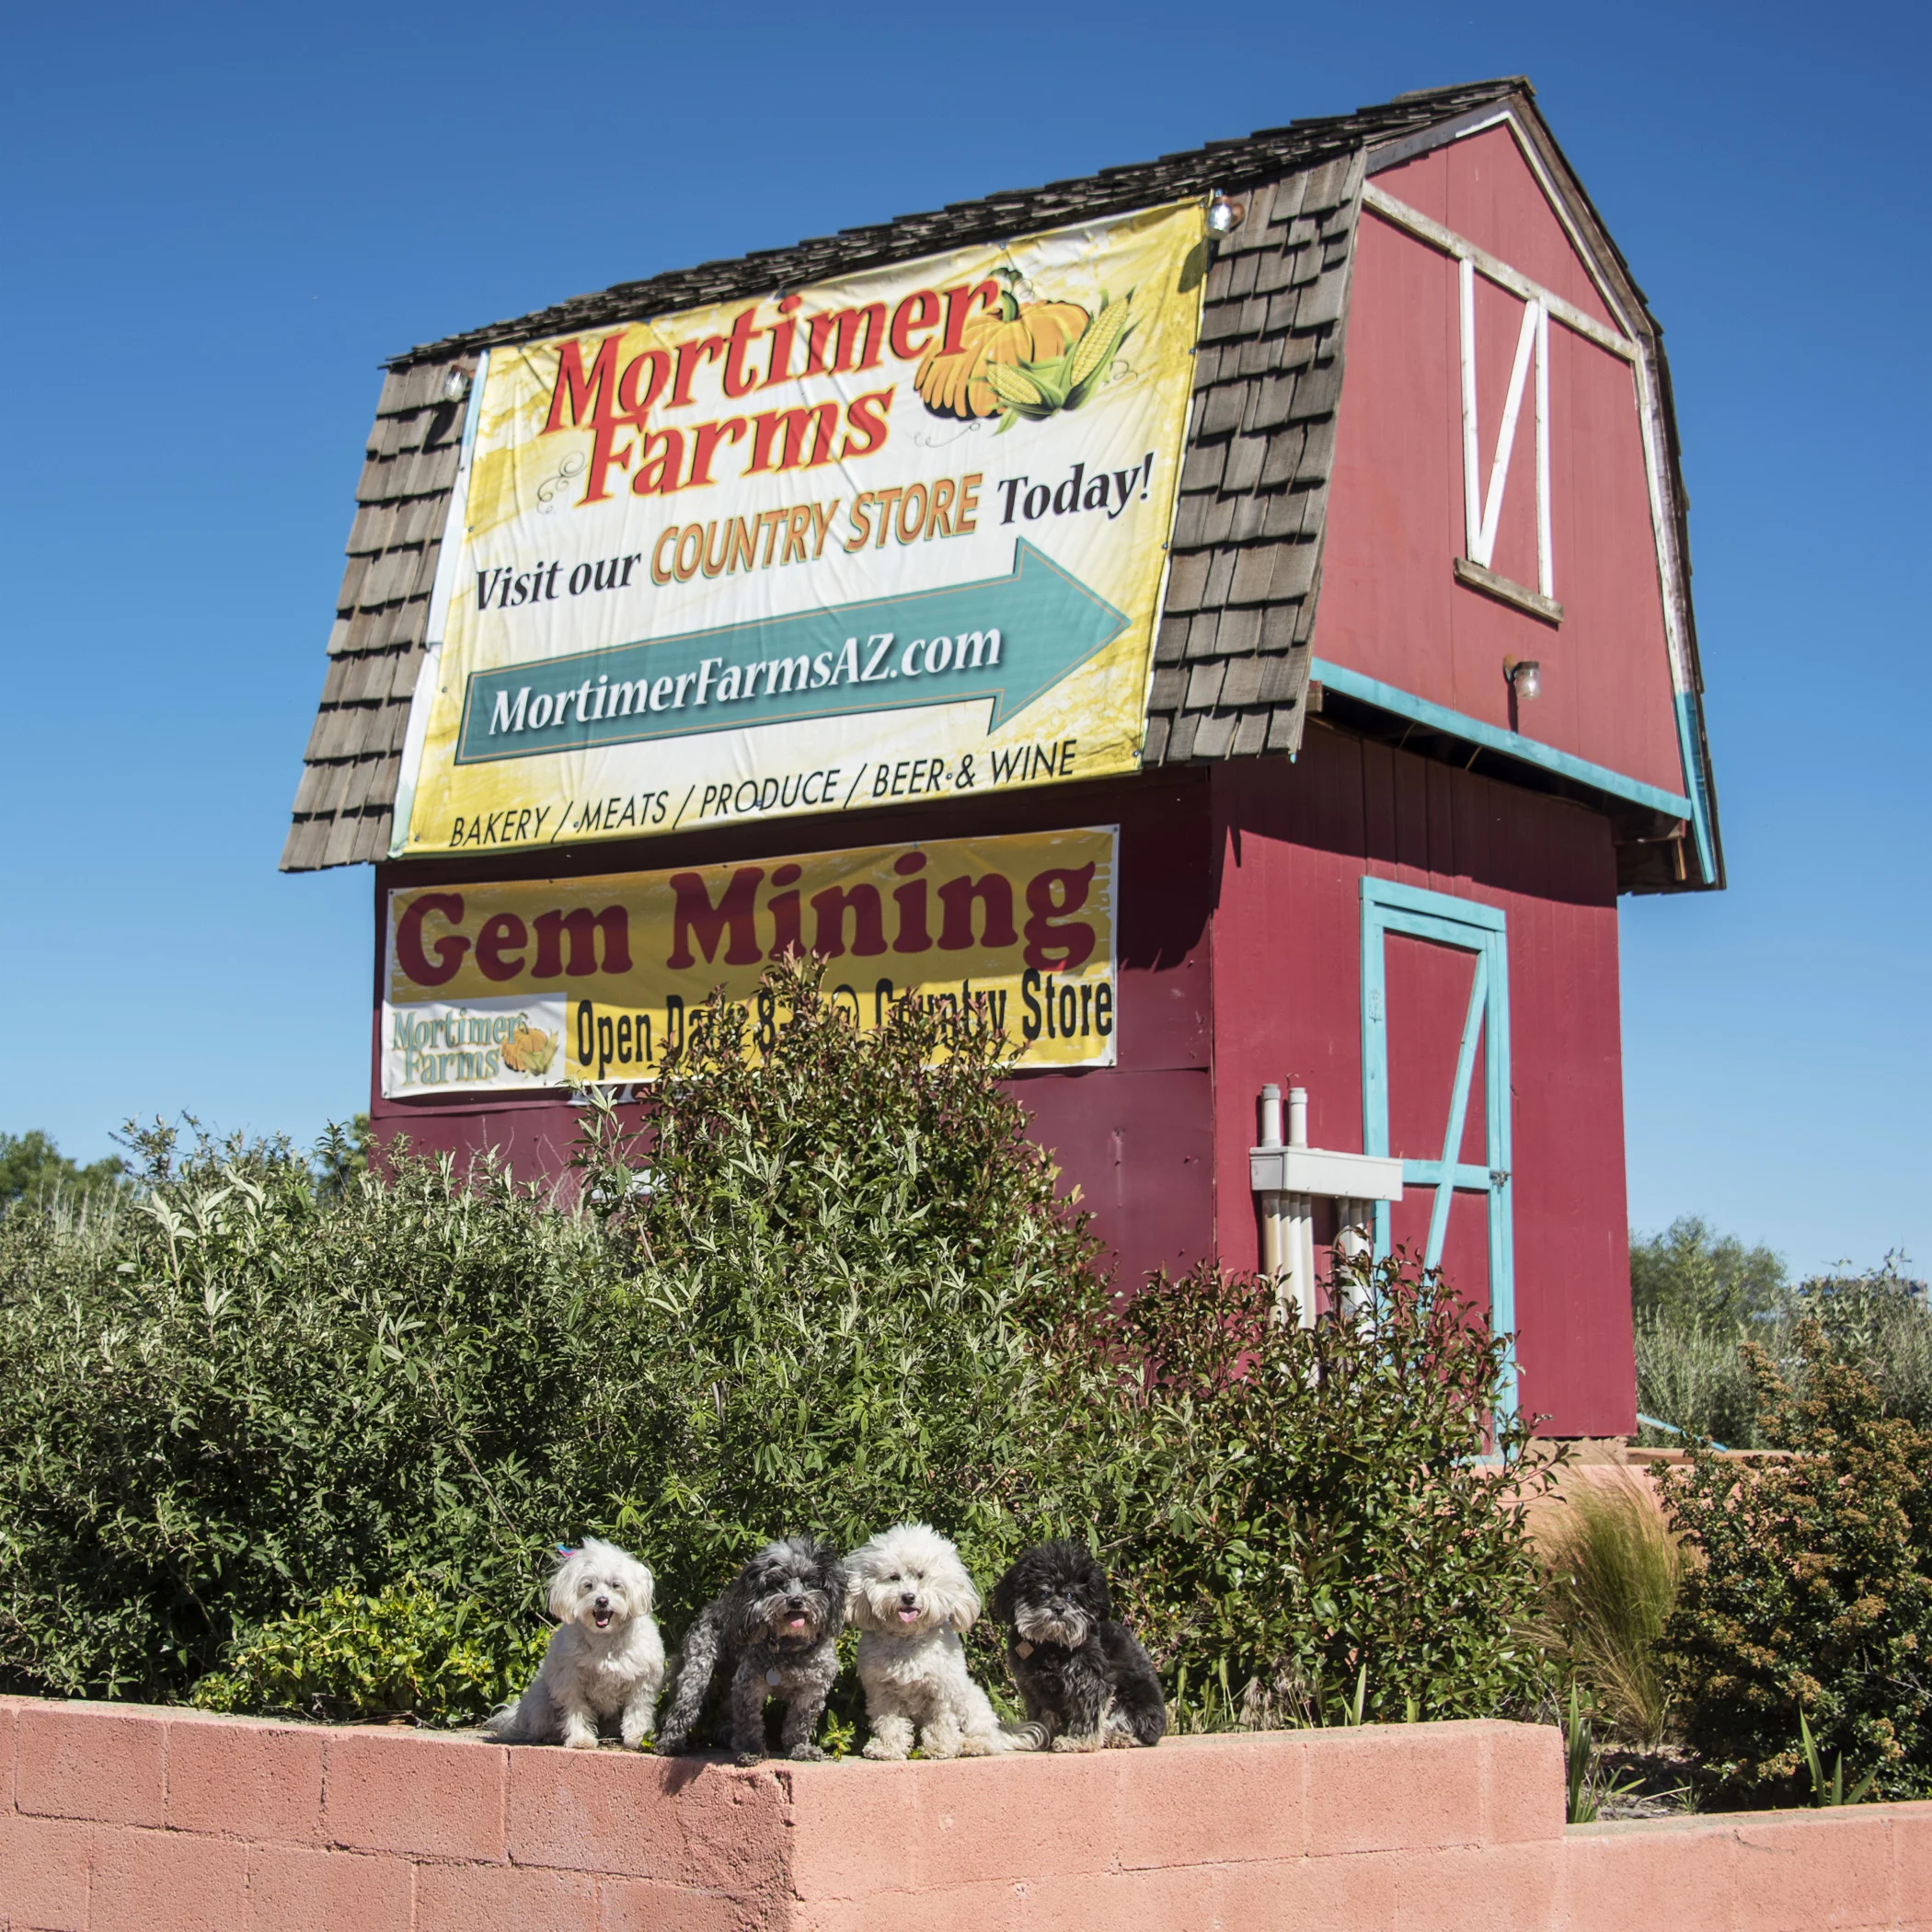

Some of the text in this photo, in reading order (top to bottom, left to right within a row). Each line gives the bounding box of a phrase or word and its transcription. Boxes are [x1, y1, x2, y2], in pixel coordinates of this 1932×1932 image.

[538, 280, 1000, 435] Mortimer
[575, 383, 896, 508] Farms
[477, 452, 1155, 611] Visit our COUNTRY STORE Today!
[488, 627, 1004, 736] MortimerFarmsAZ.com
[449, 806, 551, 847] BAKERY
[577, 790, 669, 834] MEATS
[699, 769, 841, 818] PRODUCE
[872, 758, 944, 799] BEER
[955, 753, 976, 789] &
[991, 740, 1077, 785] WINE
[396, 851, 1096, 987] Gem Mining
[392, 1007, 523, 1051] Mortimer
[402, 1046, 501, 1086] Farms
[578, 999, 652, 1080] Open
[1022, 968, 1113, 1041] Store
